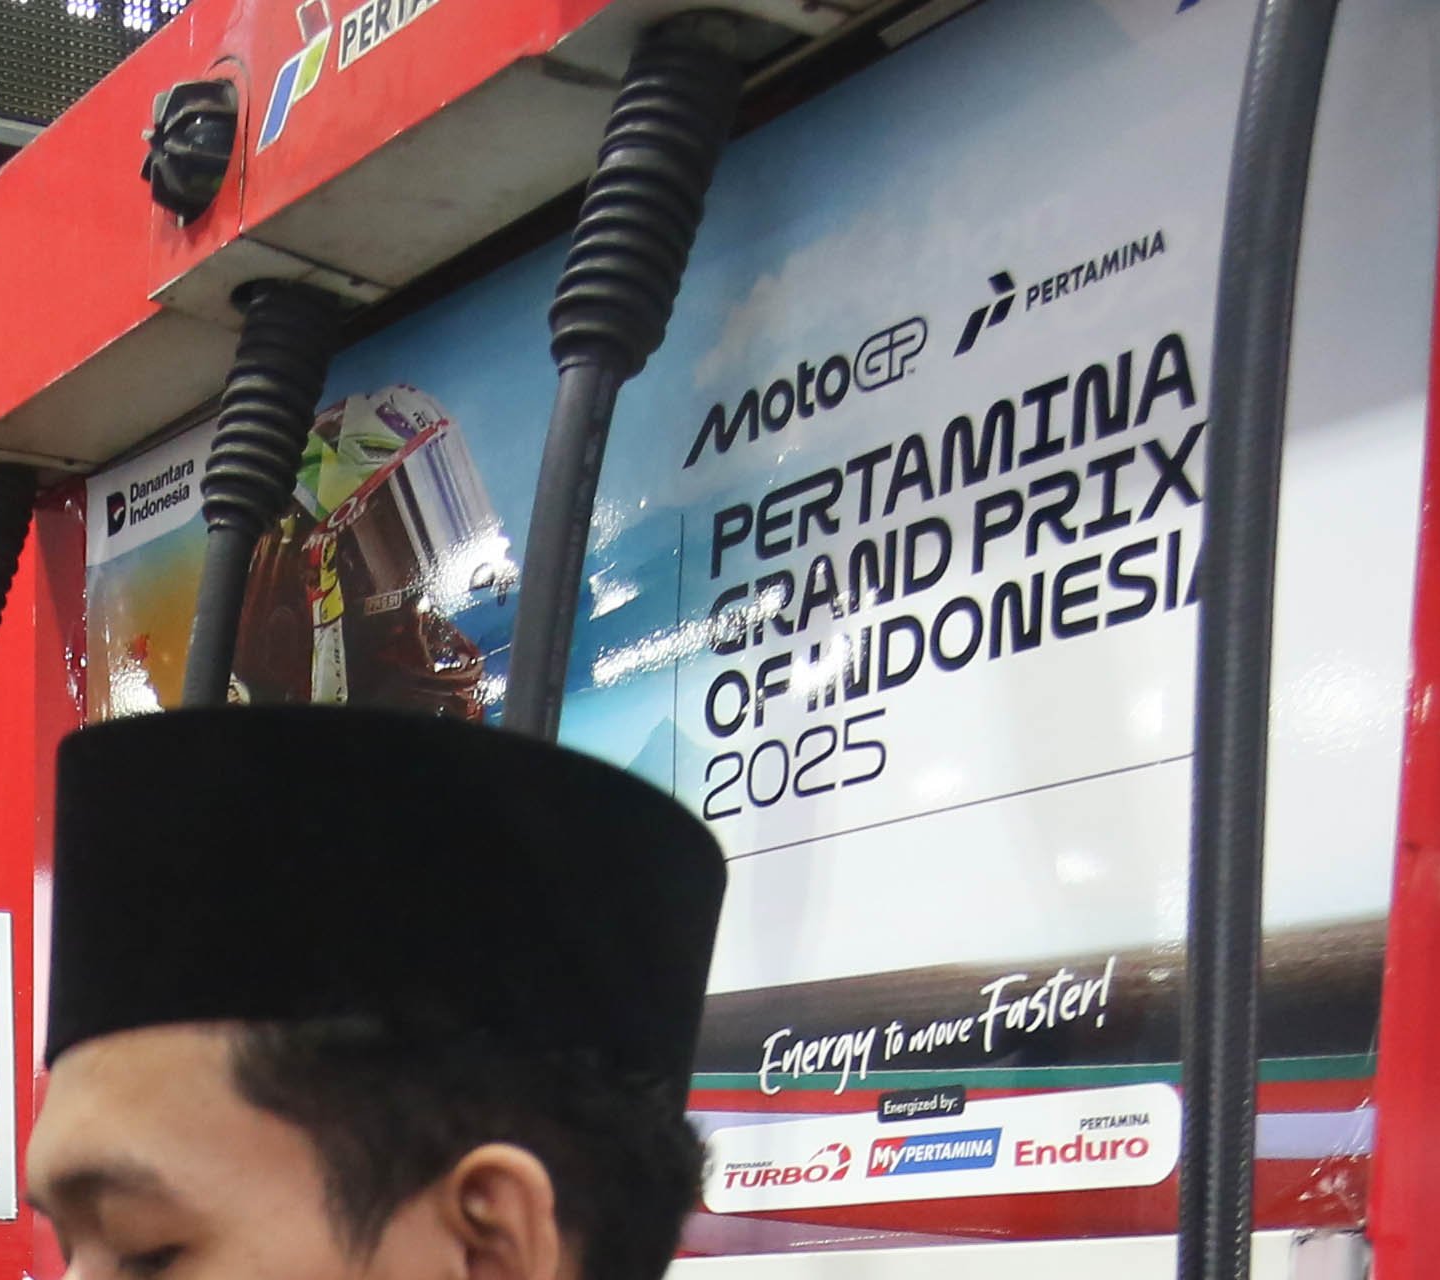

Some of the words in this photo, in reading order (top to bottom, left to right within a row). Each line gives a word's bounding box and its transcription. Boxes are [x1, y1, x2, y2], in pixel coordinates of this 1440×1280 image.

[1025, 230, 1167, 311] PERTAMINA
[683, 316, 928, 469] MotoGP
[129, 459, 195, 501] Danantara
[710, 332, 1197, 578] PERTAMINA
[129, 487, 191, 526] Indonesia
[710, 516, 953, 656] GRAND
[971, 420, 1208, 574] PRIX
[704, 652, 793, 738] OF
[703, 709, 887, 821] 2025
[758, 1026, 874, 1095] Energy
[884, 1020, 902, 1062] to
[908, 1016, 971, 1053] move
[978, 955, 1116, 1053] Faster!
[883, 1095, 937, 1116] Energized
[940, 1095, 960, 1113] by:
[1079, 1112, 1150, 1131] PERTAMINA
[723, 1163, 829, 1190] TURBO
[1014, 1133, 1150, 1167] Enduro
